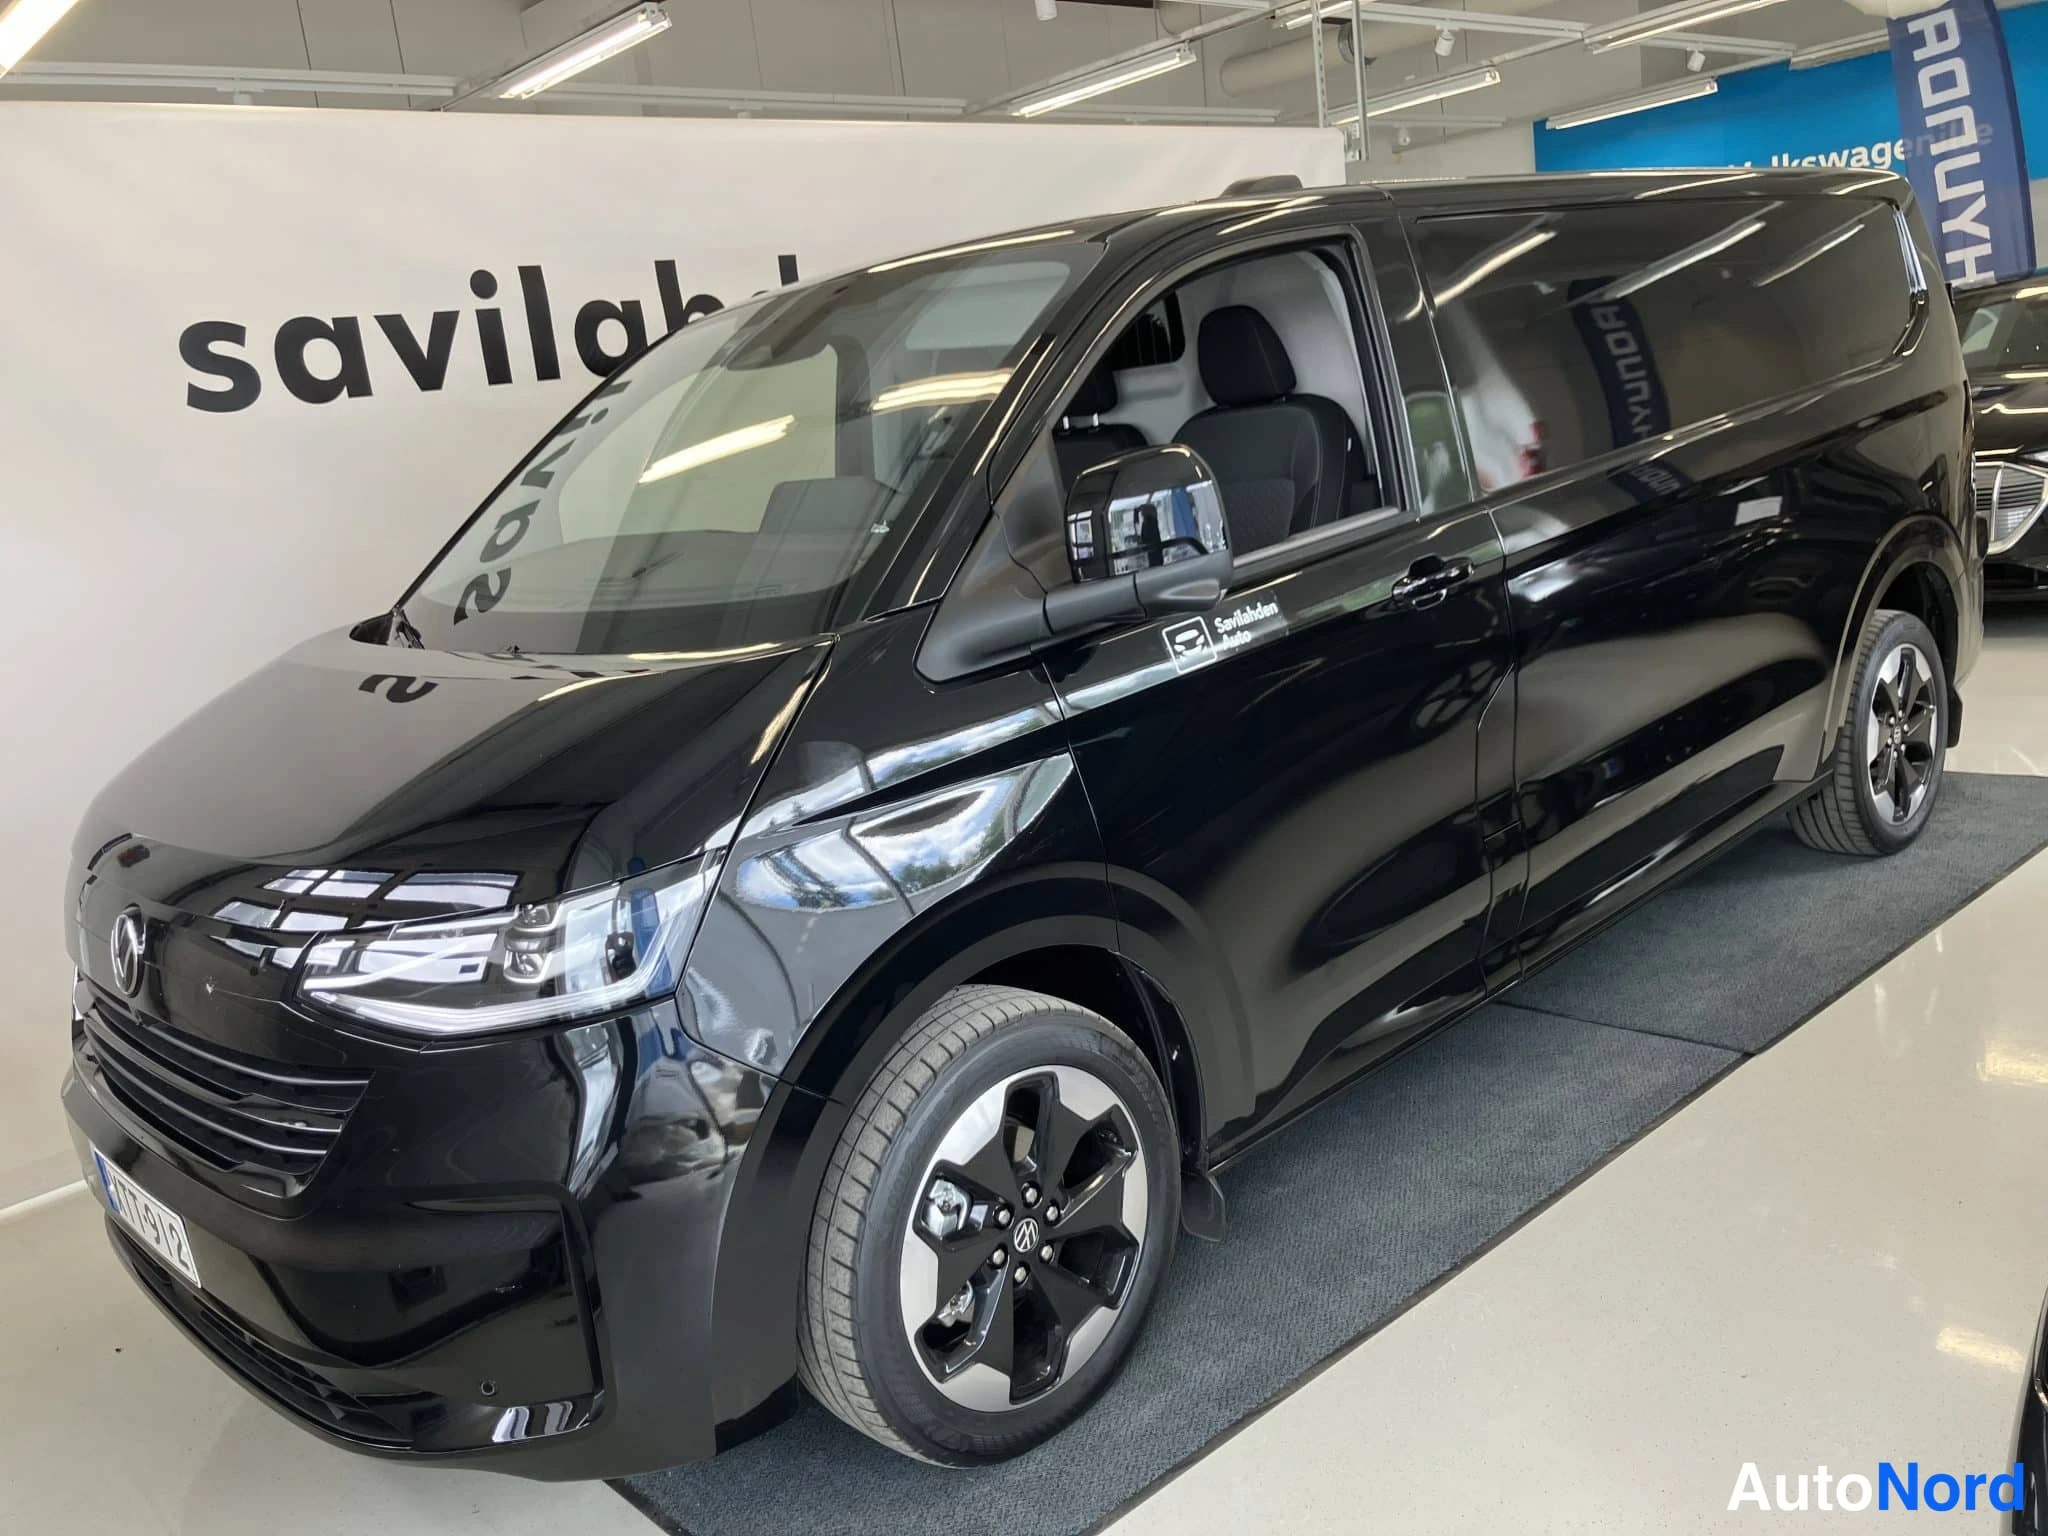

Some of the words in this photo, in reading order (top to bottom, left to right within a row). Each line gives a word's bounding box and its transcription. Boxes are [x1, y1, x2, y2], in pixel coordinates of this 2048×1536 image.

[178, 254, 799, 413] savilah
[1214, 601, 1279, 634] Savilahden
[1222, 629, 1251, 650] Auto
